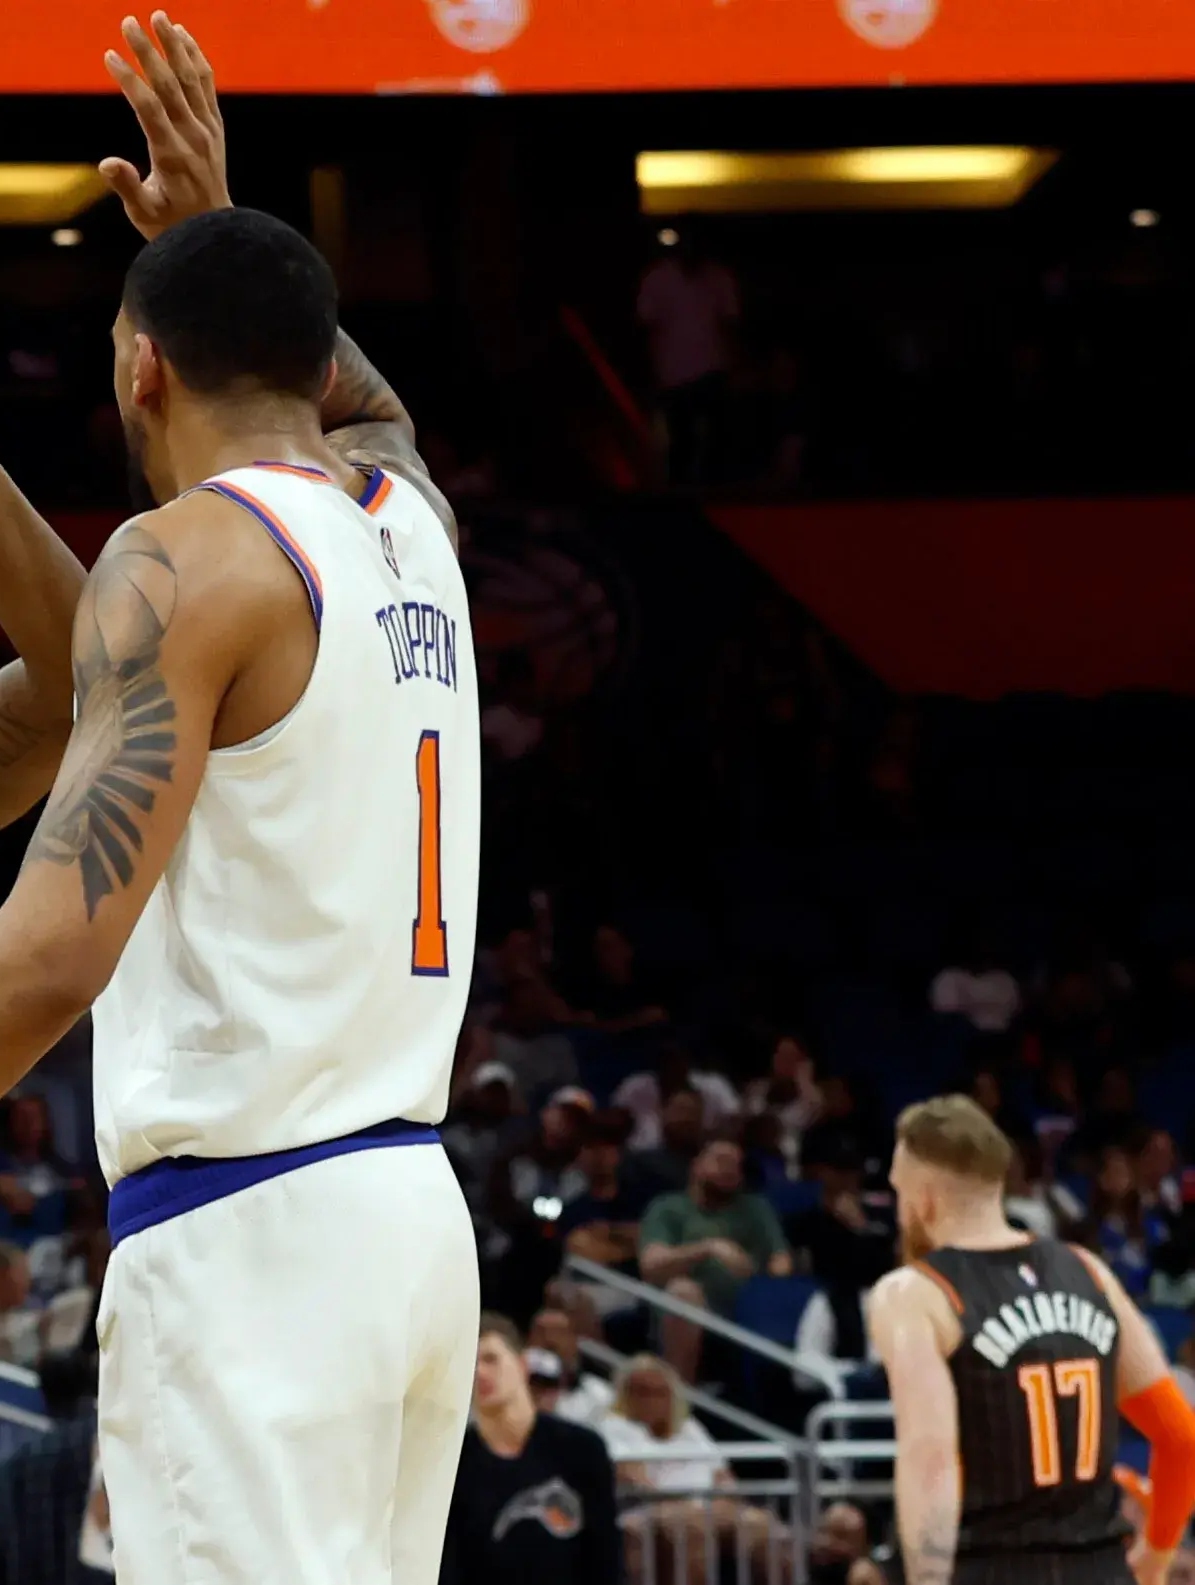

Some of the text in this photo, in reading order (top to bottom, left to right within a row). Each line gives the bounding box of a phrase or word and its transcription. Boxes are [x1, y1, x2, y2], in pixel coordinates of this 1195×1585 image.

[375, 601, 457, 694] TOPPIN
[411, 729, 449, 977] 1
[1017, 1357, 1101, 1488] 17
